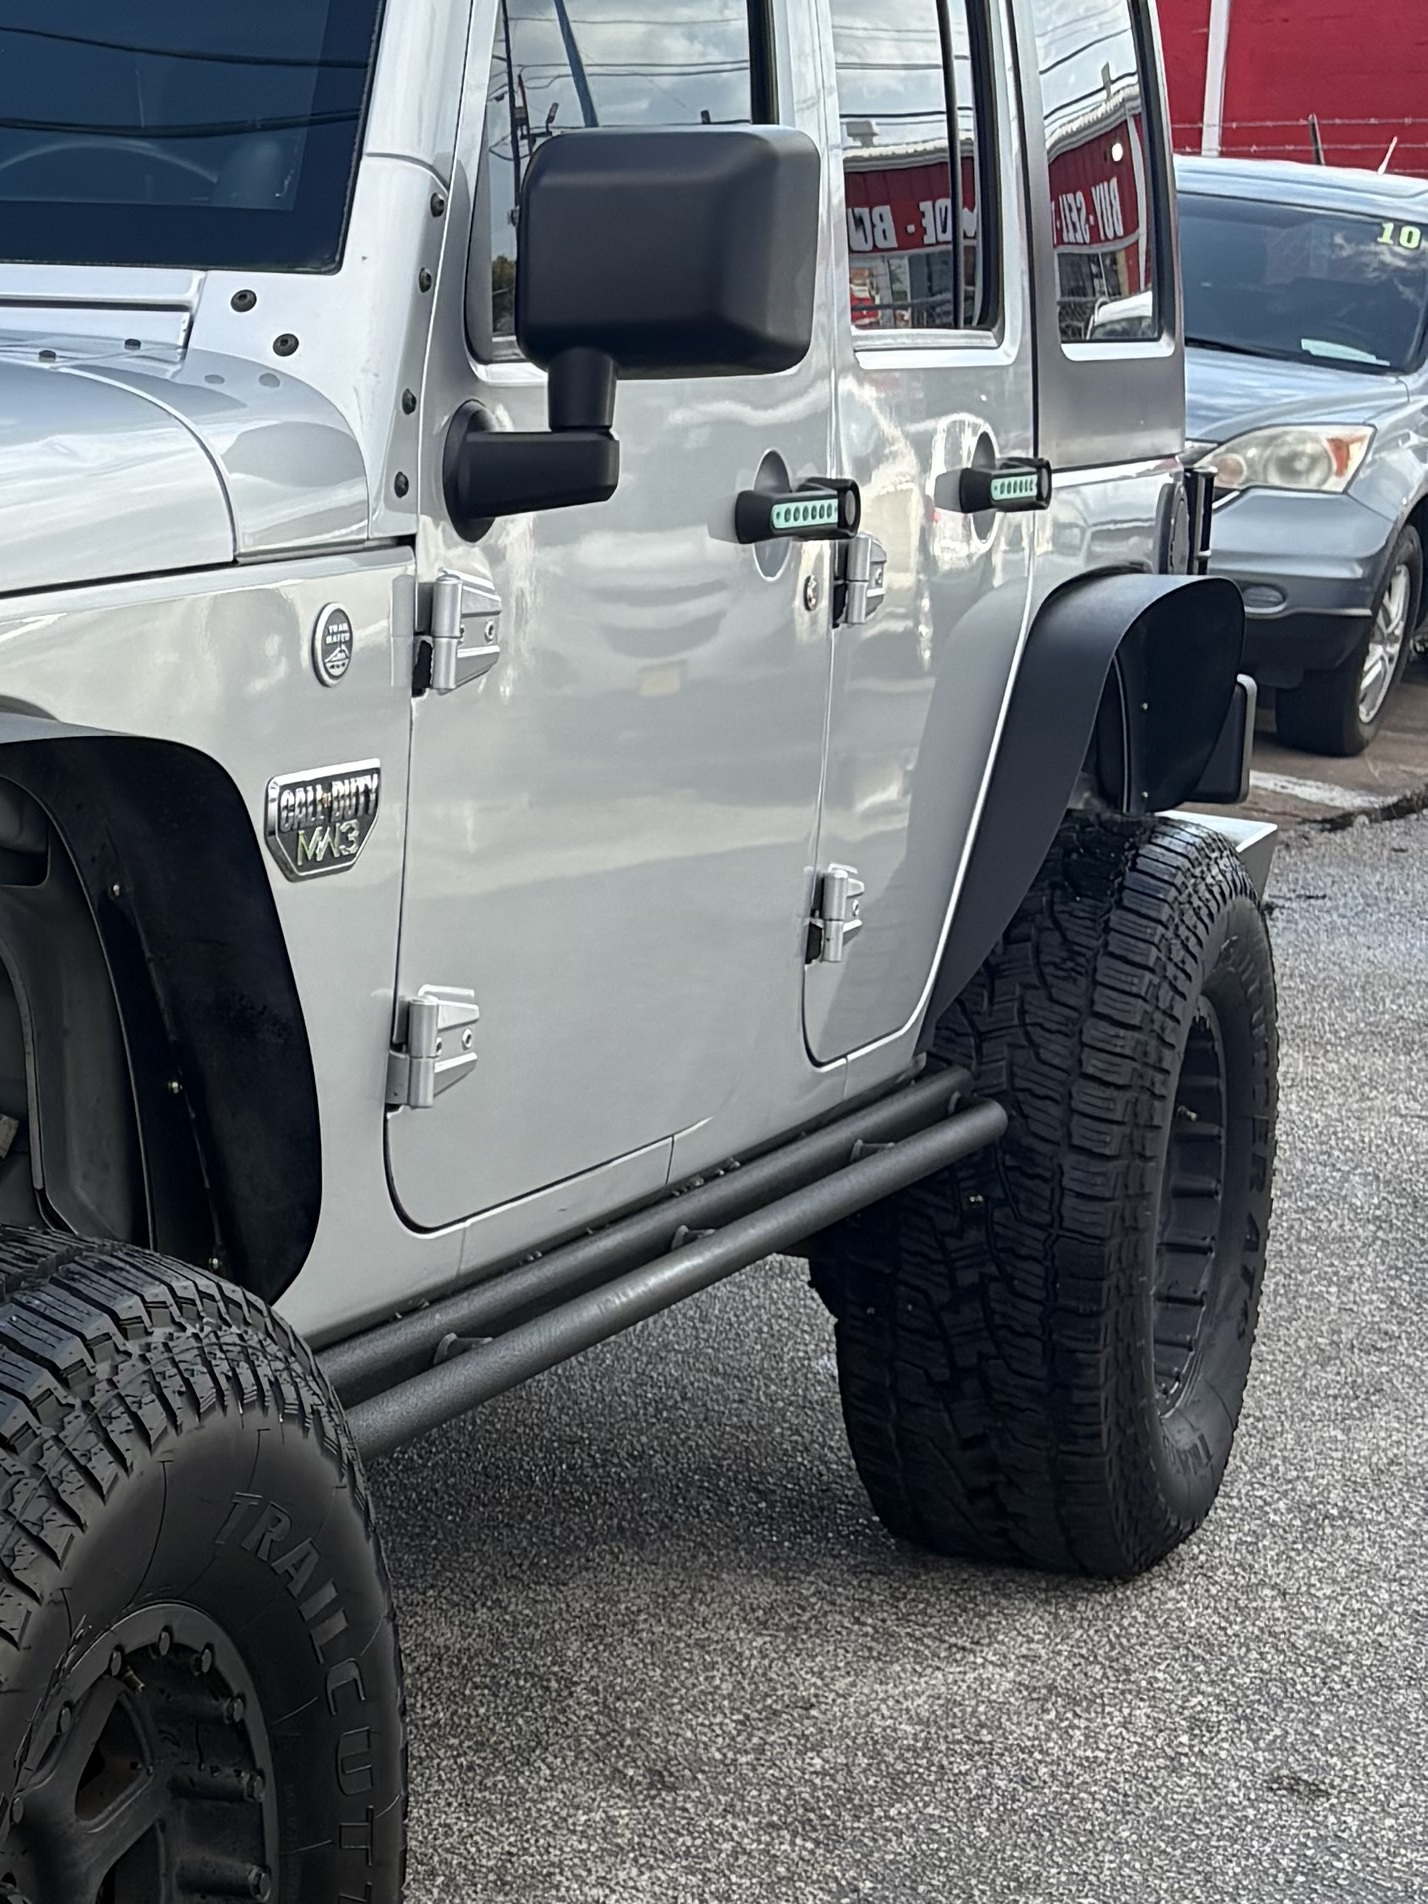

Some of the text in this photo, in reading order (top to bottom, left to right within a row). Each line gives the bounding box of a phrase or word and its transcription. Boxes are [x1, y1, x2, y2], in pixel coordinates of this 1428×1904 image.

[1376, 222, 1421, 249] 10
[280, 784, 325, 833] CALL
[331, 773, 379, 823] DUTY
[297, 819, 360, 866] MW3
